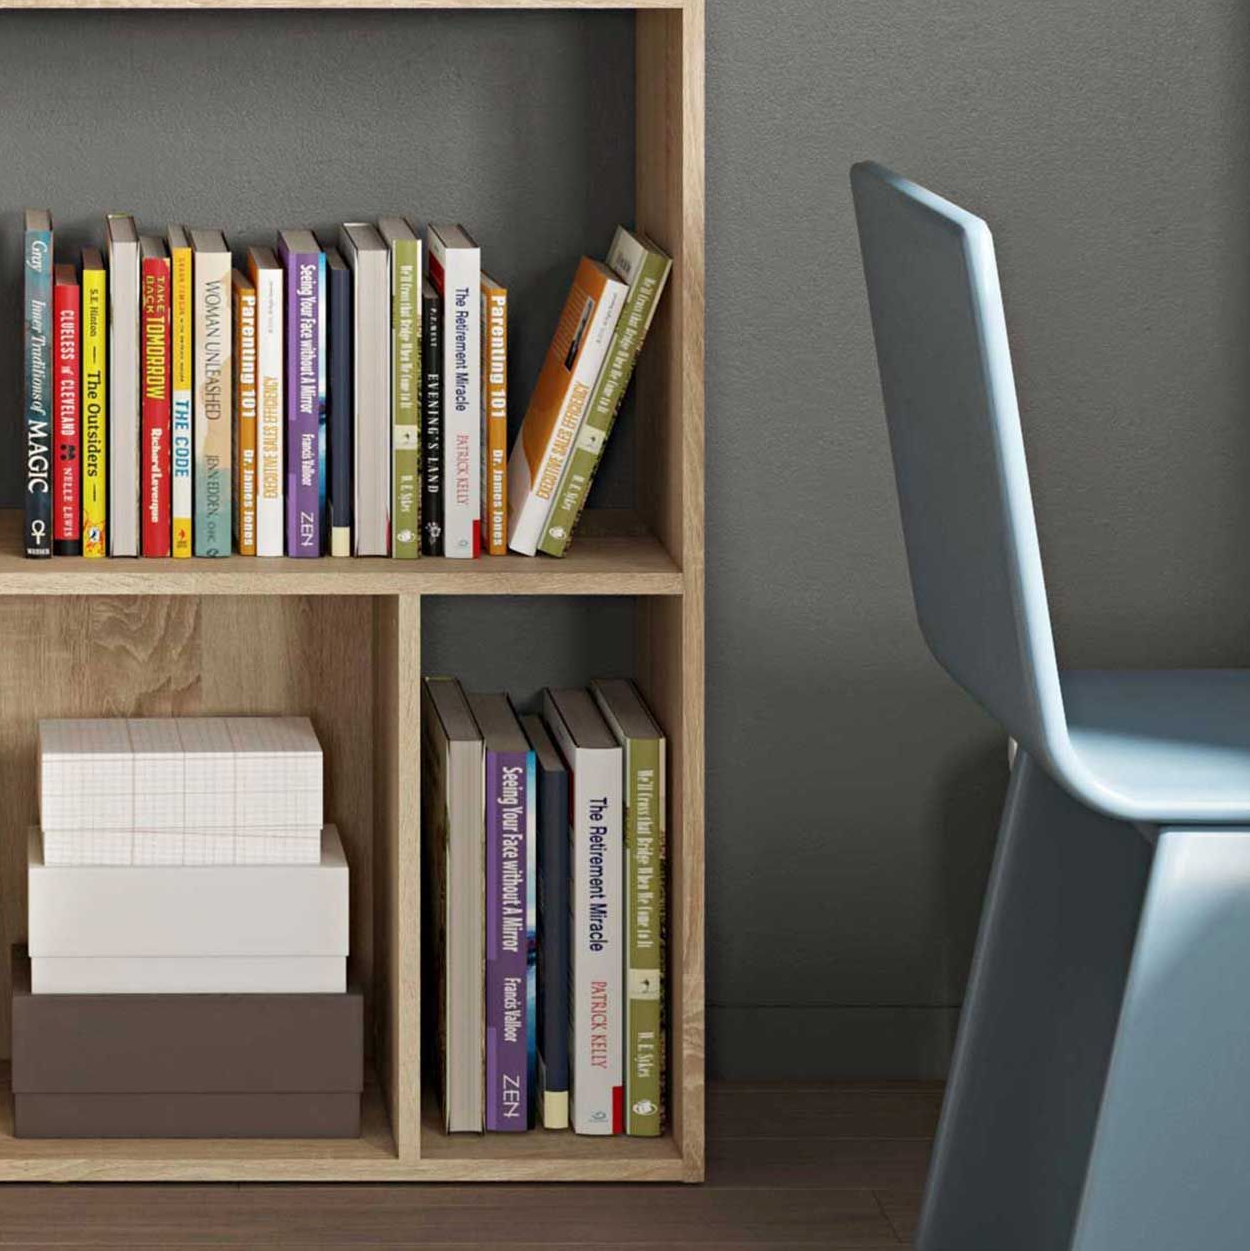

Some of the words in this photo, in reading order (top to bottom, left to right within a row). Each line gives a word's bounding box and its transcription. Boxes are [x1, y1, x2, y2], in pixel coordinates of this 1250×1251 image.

[27, 240, 48, 271] Gray
[146, 275, 155, 313] BACK
[157, 275, 165, 313] TAKE
[205, 280, 221, 340] WOMAN
[455, 287, 469, 307] The
[29, 300, 47, 332] Inner
[60, 309, 75, 360] CLUELESS
[89, 306, 99, 337] Hinton
[146, 317, 165, 399] TOMORROW
[455, 310, 469, 369] Retirement
[490, 296, 505, 384] Parenting
[29, 334, 47, 399] Traditions
[87, 370, 101, 400] The
[205, 342, 221, 420] UNLEASHED
[28, 400, 47, 414] of
[60, 379, 75, 436] CLEVELAND
[455, 372, 469, 411] Miracle
[491, 389, 506, 417] 101
[175, 400, 189, 430] THE
[28, 419, 48, 494] MAGIC
[87, 403, 101, 476] Outsiders
[151, 428, 163, 472] Richard
[175, 436, 189, 477] CODE
[456, 435, 469, 476] PATRICK
[205, 455, 220, 480] JENN
[429, 457, 439, 493] LAND
[492, 450, 504, 467] Dr.
[63, 467, 74, 501] NELLE
[456, 478, 469, 505] KELLY
[492, 470, 504, 508] James
[63, 506, 74, 536] LEWIS
[492, 510, 504, 546] Jones
[501, 767, 522, 804] Seeing
[503, 807, 522, 831] Your
[589, 797, 608, 821] The
[503, 833, 522, 857] Face
[589, 825, 608, 899] Retirement
[503, 859, 523, 904] without
[503, 906, 522, 914] A
[589, 903, 608, 952] Miracle
[503, 916, 523, 951] Mirror
[504, 977, 521, 1009] Francis
[591, 981, 607, 1029] PATRICK
[591, 1034, 607, 1068] KELLY
[502, 1075, 520, 1118] ZEN
